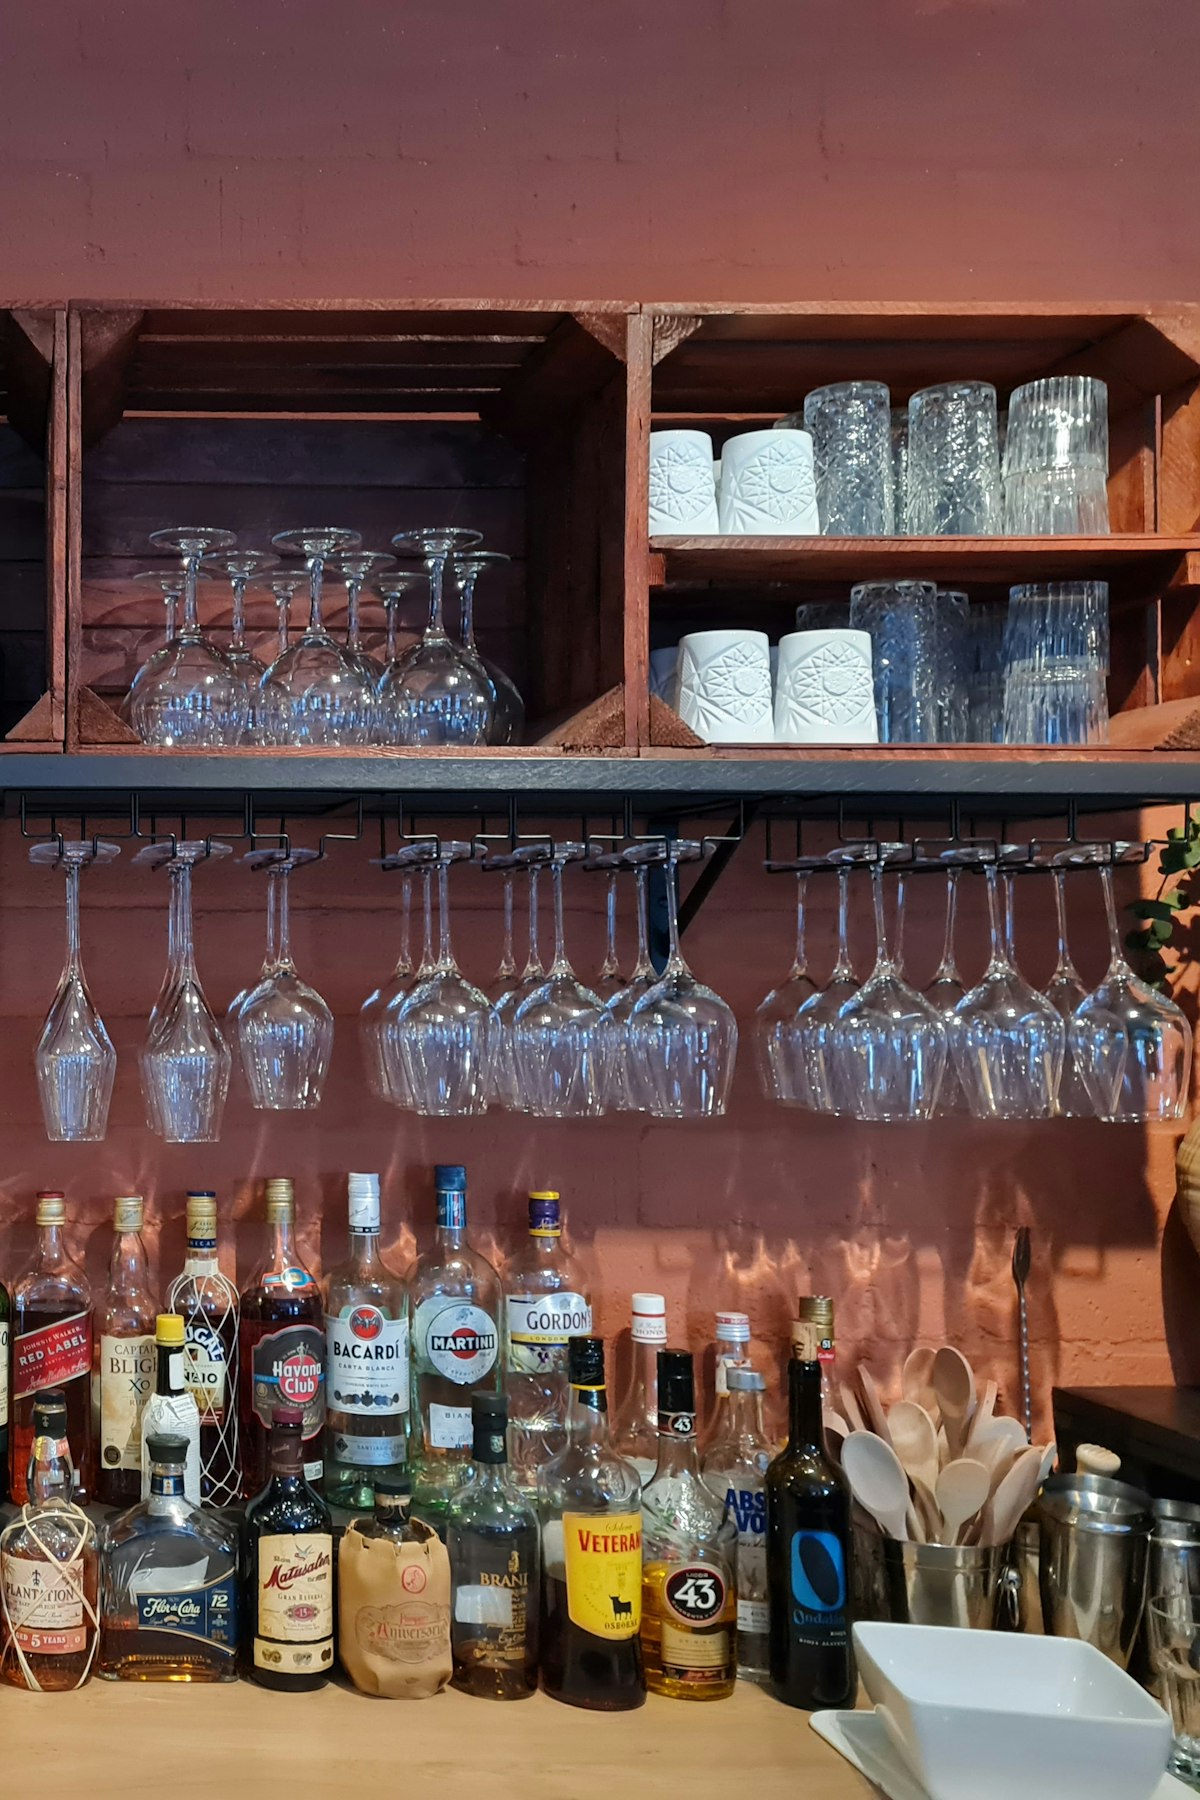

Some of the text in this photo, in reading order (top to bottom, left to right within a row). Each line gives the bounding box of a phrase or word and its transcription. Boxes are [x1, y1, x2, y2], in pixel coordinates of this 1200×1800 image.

[23, 1337, 52, 1353] JOHNNIE
[334, 1340, 400, 1360] BACARDÍ
[433, 1335, 493, 1350] MARTINI
[19, 1335, 87, 1367] RED LABEL
[273, 1361, 321, 1377] Havana
[285, 1378, 314, 1393] Club
[674, 1418, 691, 1431] 43
[725, 1488, 765, 1511] ABS
[736, 1512, 765, 1533] VO
[211, 1594, 228, 1608] 12
[674, 1578, 716, 1609] 43
[143, 1598, 170, 1617] Flor
[177, 1598, 201, 1618] Caña
[16, 1632, 66, 1647] GED 5 YEARS
